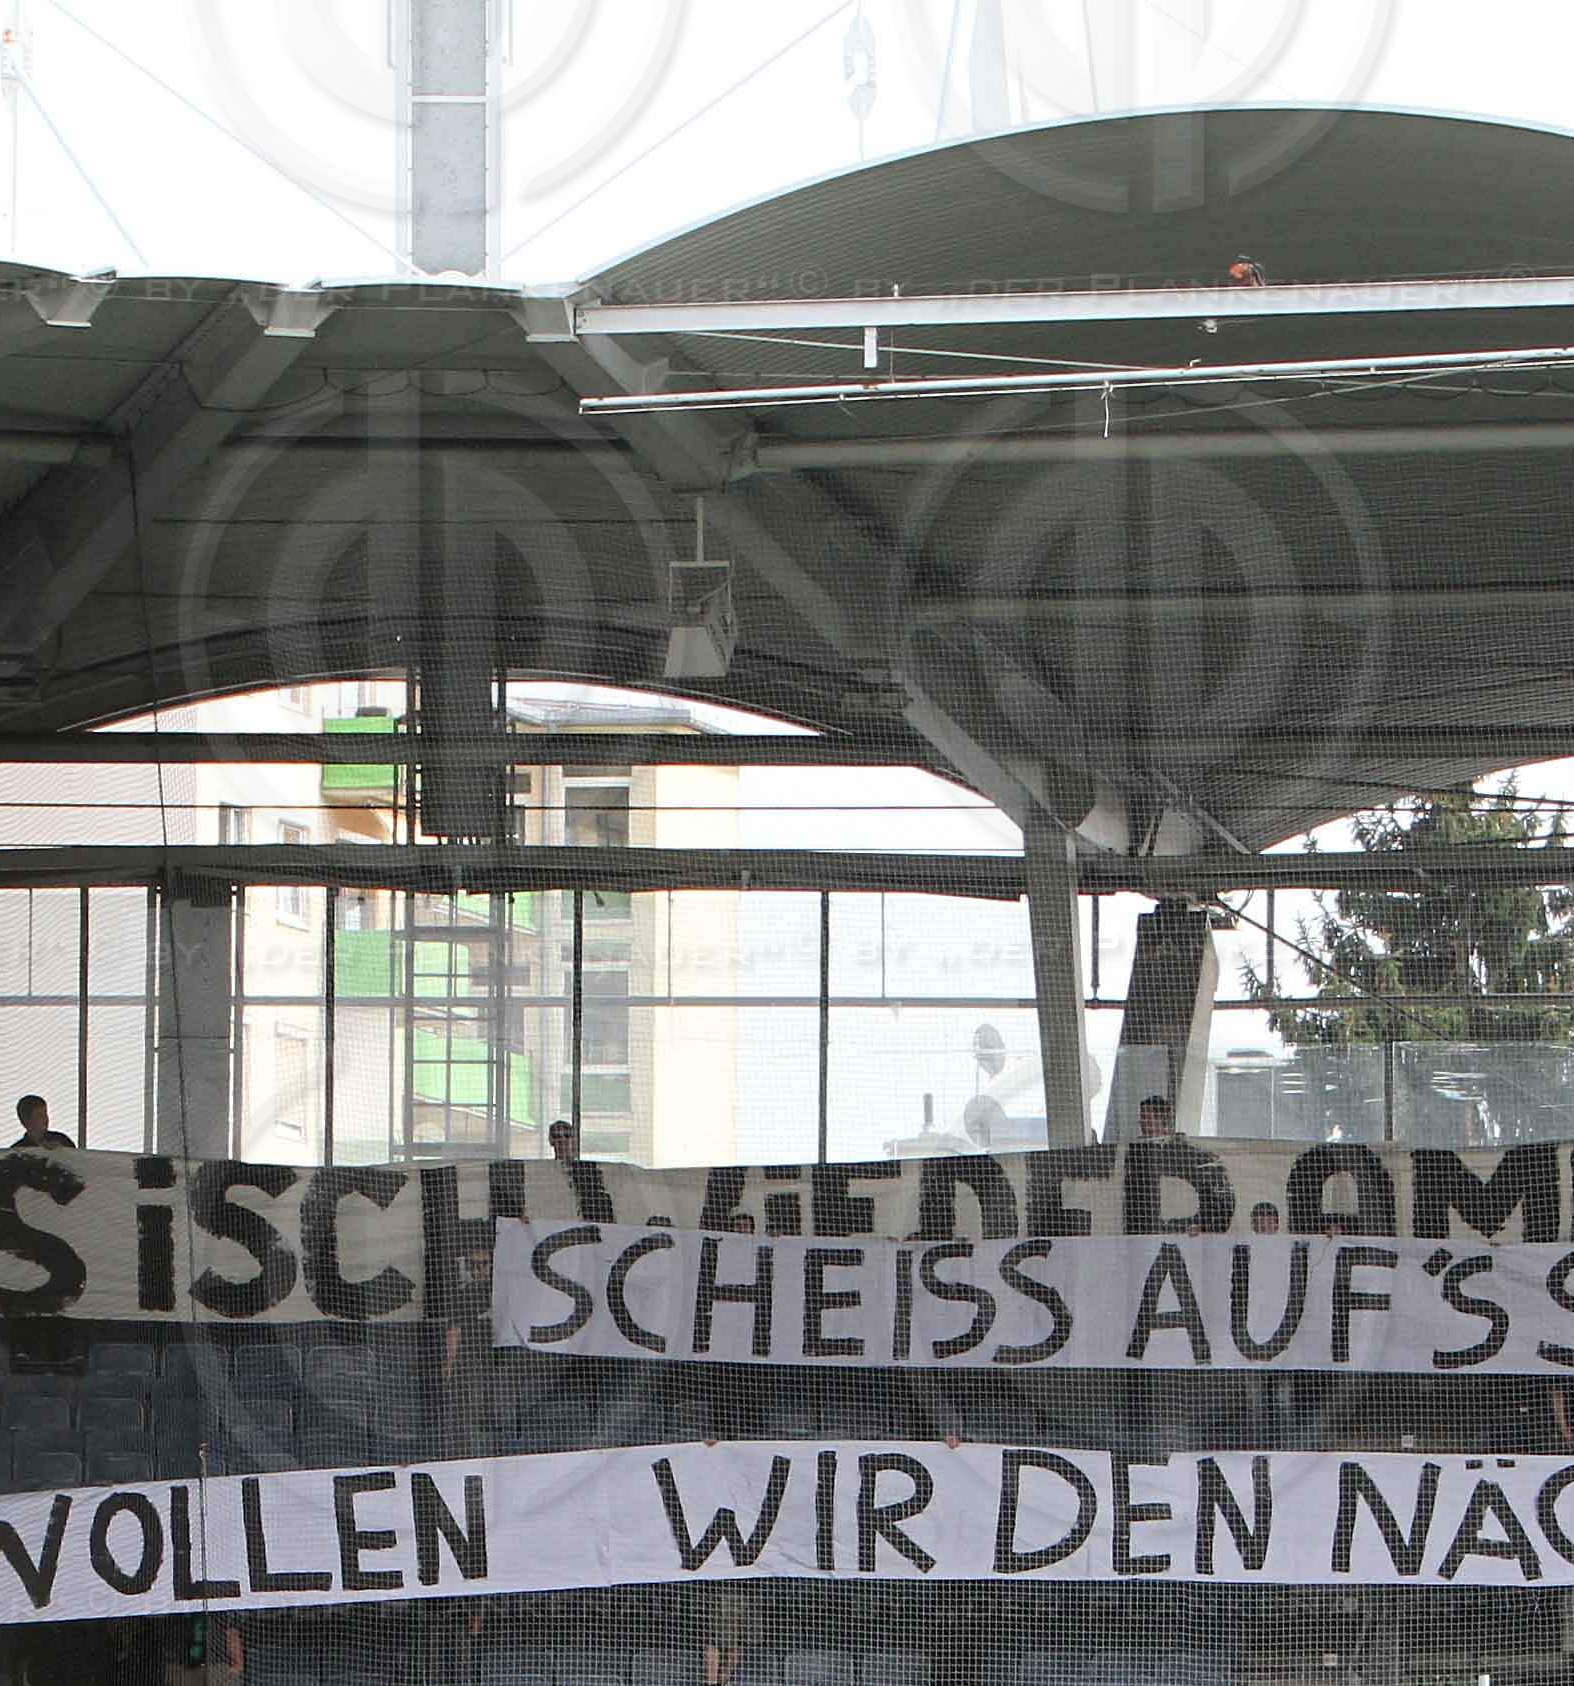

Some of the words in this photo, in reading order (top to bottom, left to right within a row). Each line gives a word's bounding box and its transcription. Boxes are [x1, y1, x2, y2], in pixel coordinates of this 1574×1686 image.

[527, 1223, 1074, 1364] SCHEISS
[651, 1450, 936, 1573] WIR
[992, 1448, 1273, 1576] DEN
